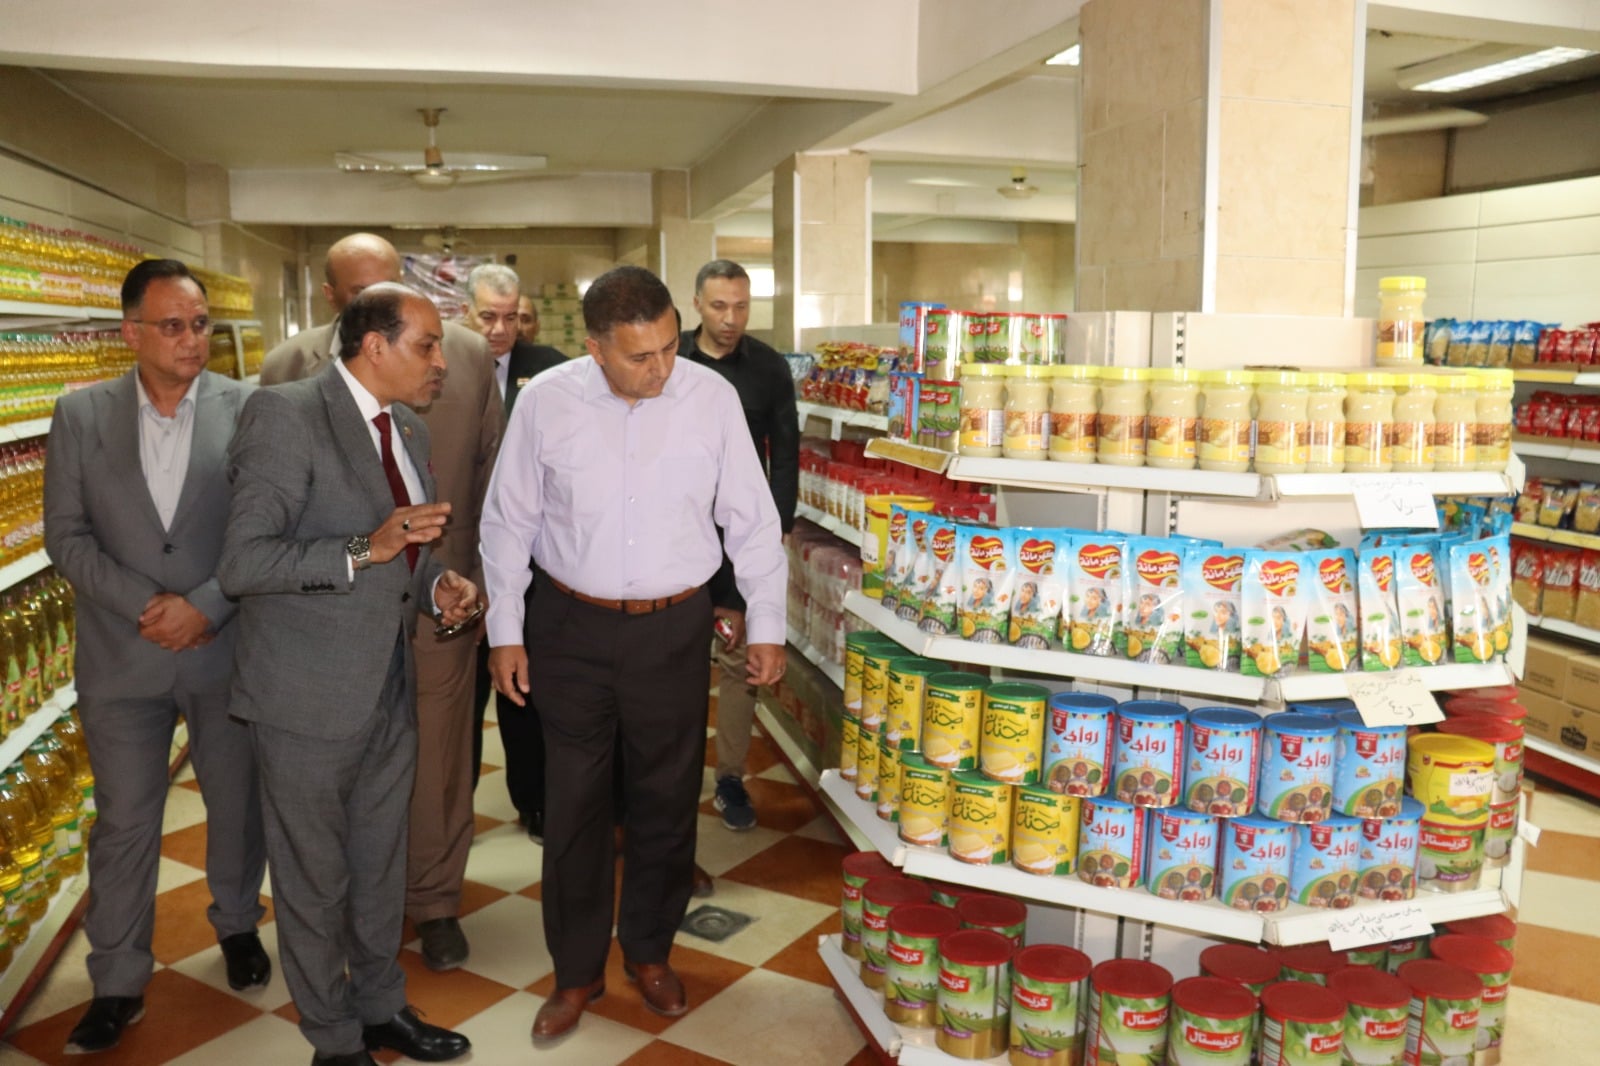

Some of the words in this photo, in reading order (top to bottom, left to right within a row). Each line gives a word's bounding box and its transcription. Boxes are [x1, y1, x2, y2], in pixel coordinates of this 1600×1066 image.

[1080, 552, 1121, 567] كهرمانة
[1137, 560, 1179, 574] كهرمانة
[1420, 832, 1469, 850] كريستال
[1189, 1031, 1240, 1049] كريستال
